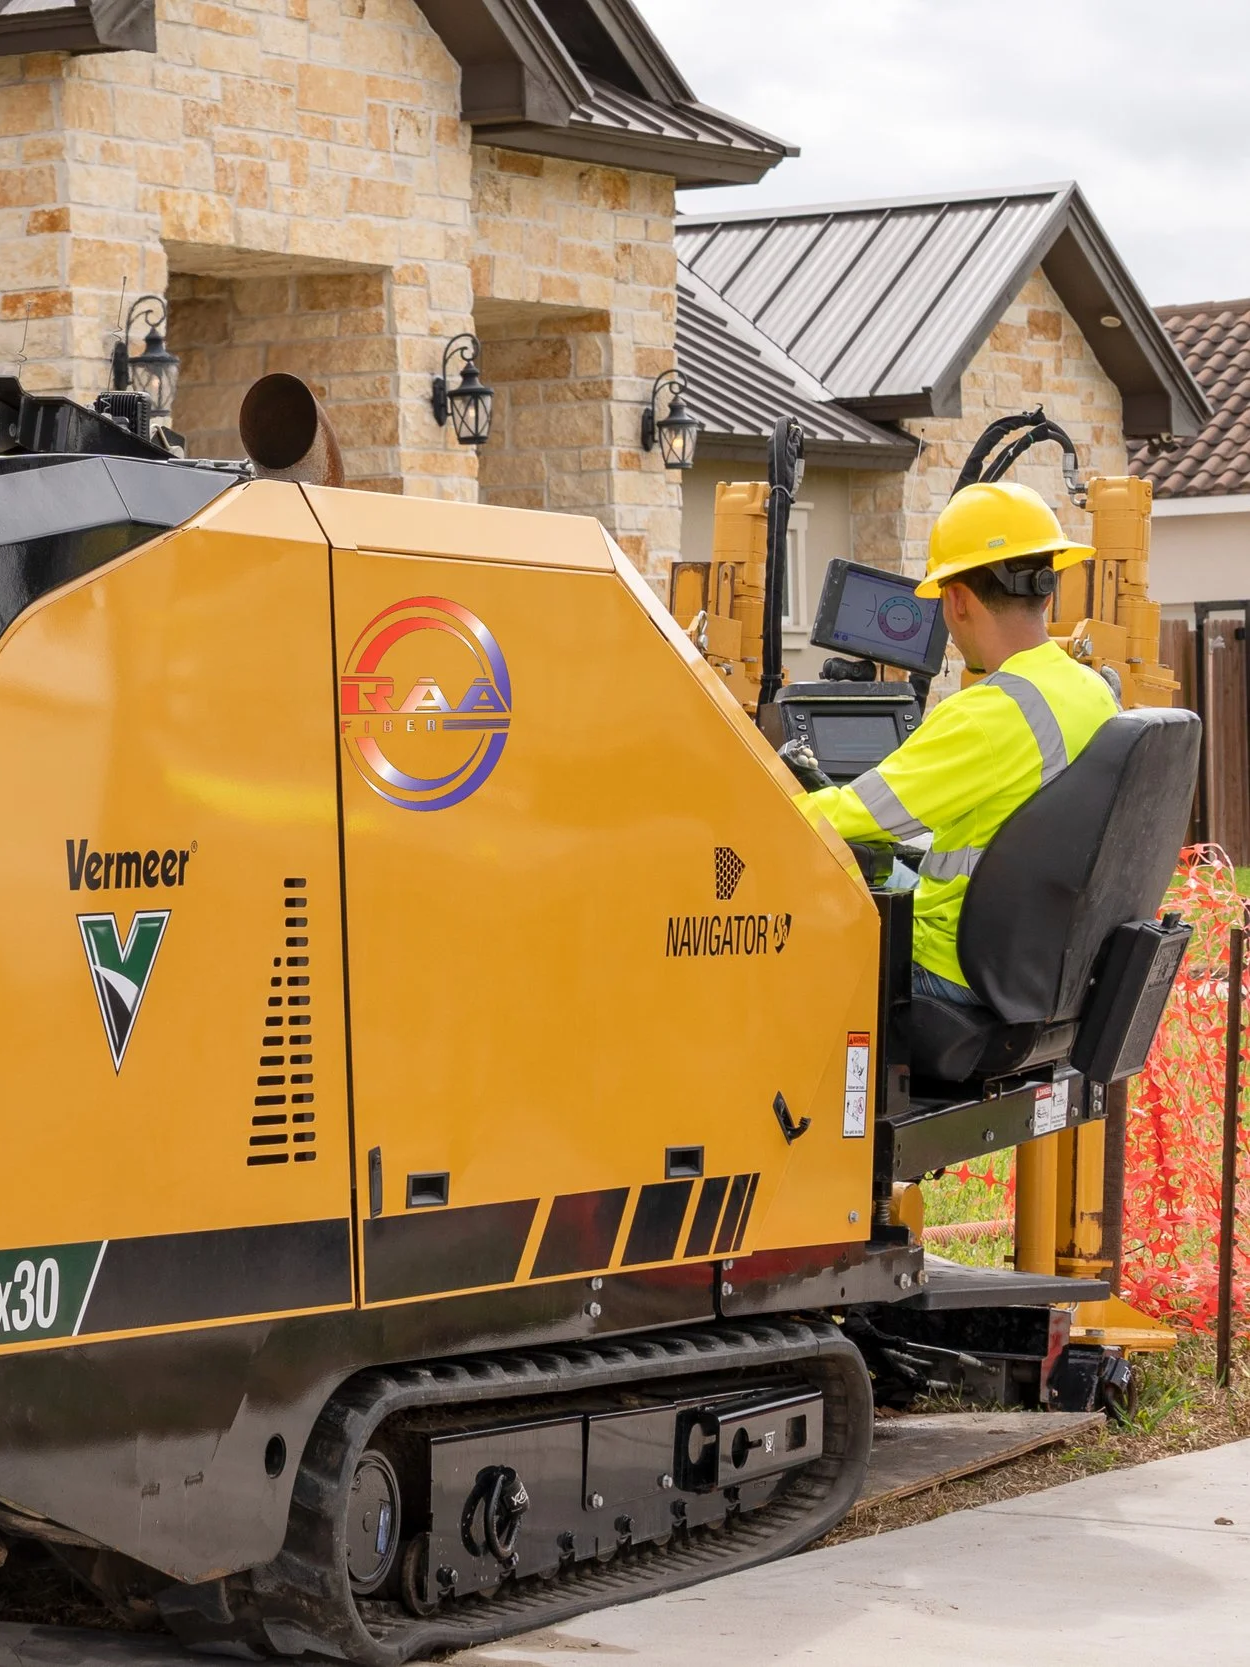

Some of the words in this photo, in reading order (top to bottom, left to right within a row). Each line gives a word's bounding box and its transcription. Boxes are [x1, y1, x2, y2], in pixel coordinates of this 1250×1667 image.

[341, 676, 508, 715] RAA
[341, 719, 436, 734] FIBER
[666, 914, 769, 957] NAVIGATOR
